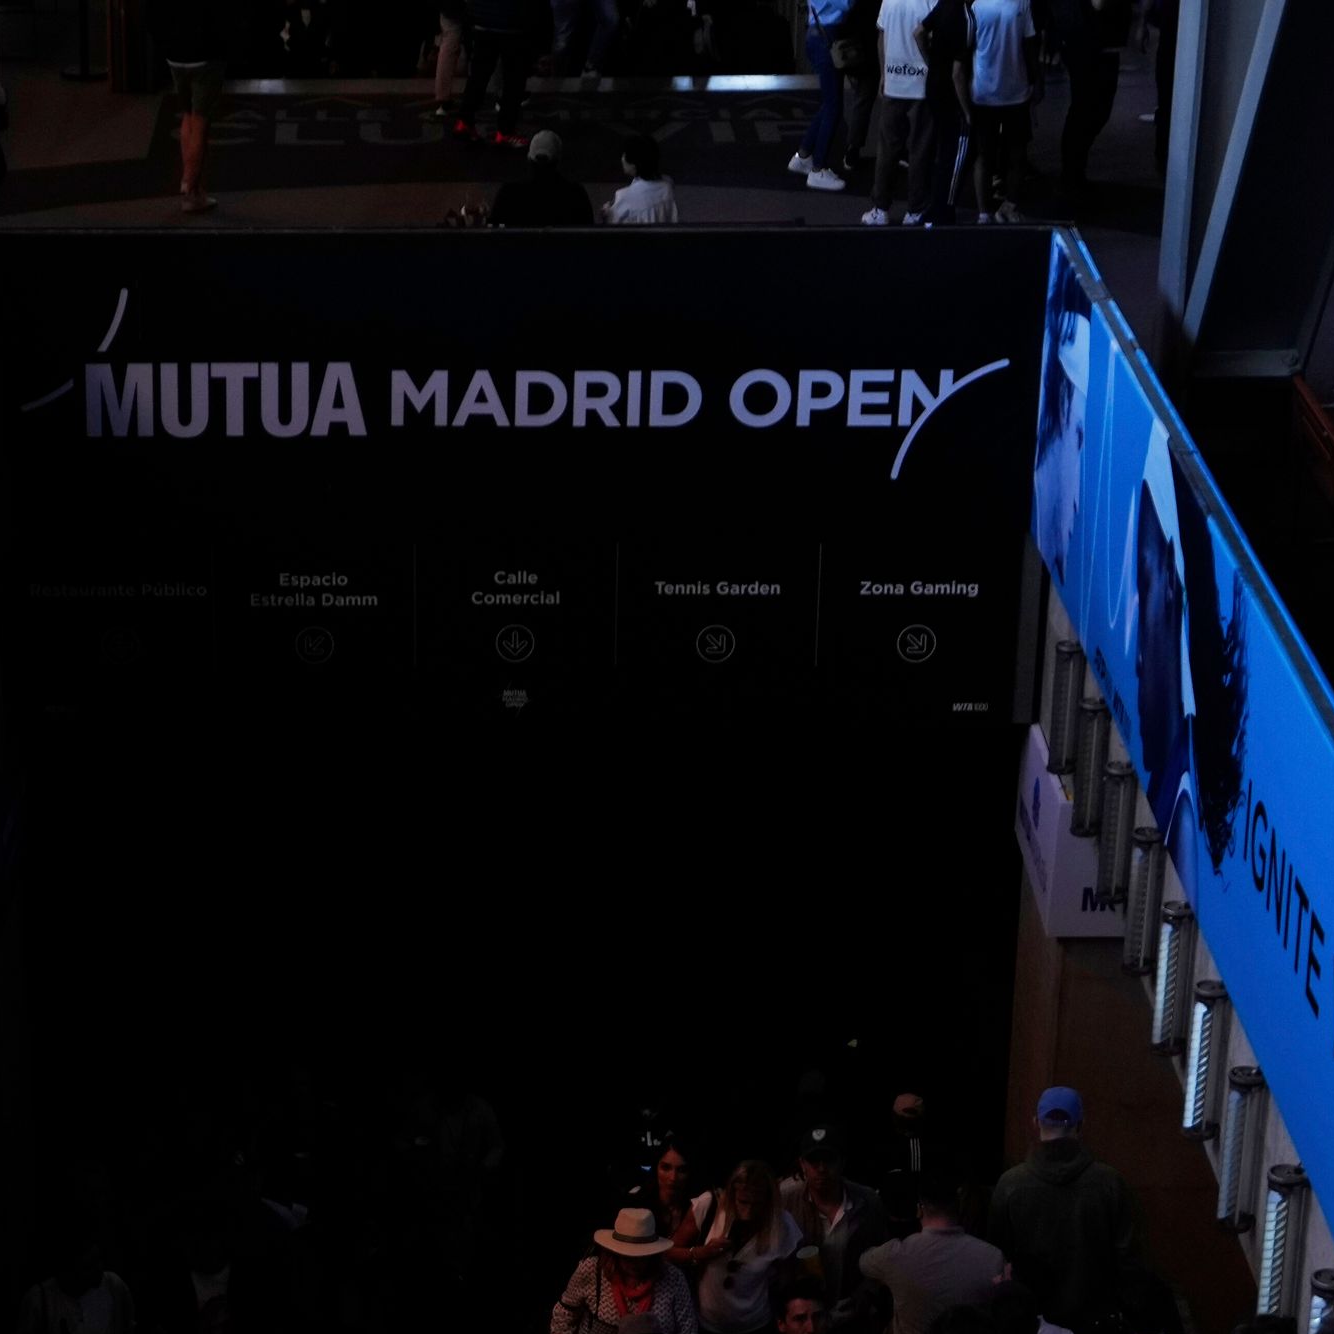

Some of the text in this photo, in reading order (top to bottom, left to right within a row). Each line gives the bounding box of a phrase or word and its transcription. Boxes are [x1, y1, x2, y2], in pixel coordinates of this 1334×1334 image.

[84, 359, 957, 438] MUTUA MADRID OPEN
[278, 570, 350, 591] Espacio
[493, 569, 539, 586] Calle
[470, 588, 562, 607] Comercial
[653, 580, 782, 597] Tennis Garden
[858, 580, 980, 599] Zona Gaming
[249, 591, 379, 608] Estrella Damm
[1241, 780, 1325, 1017] IGNITE
